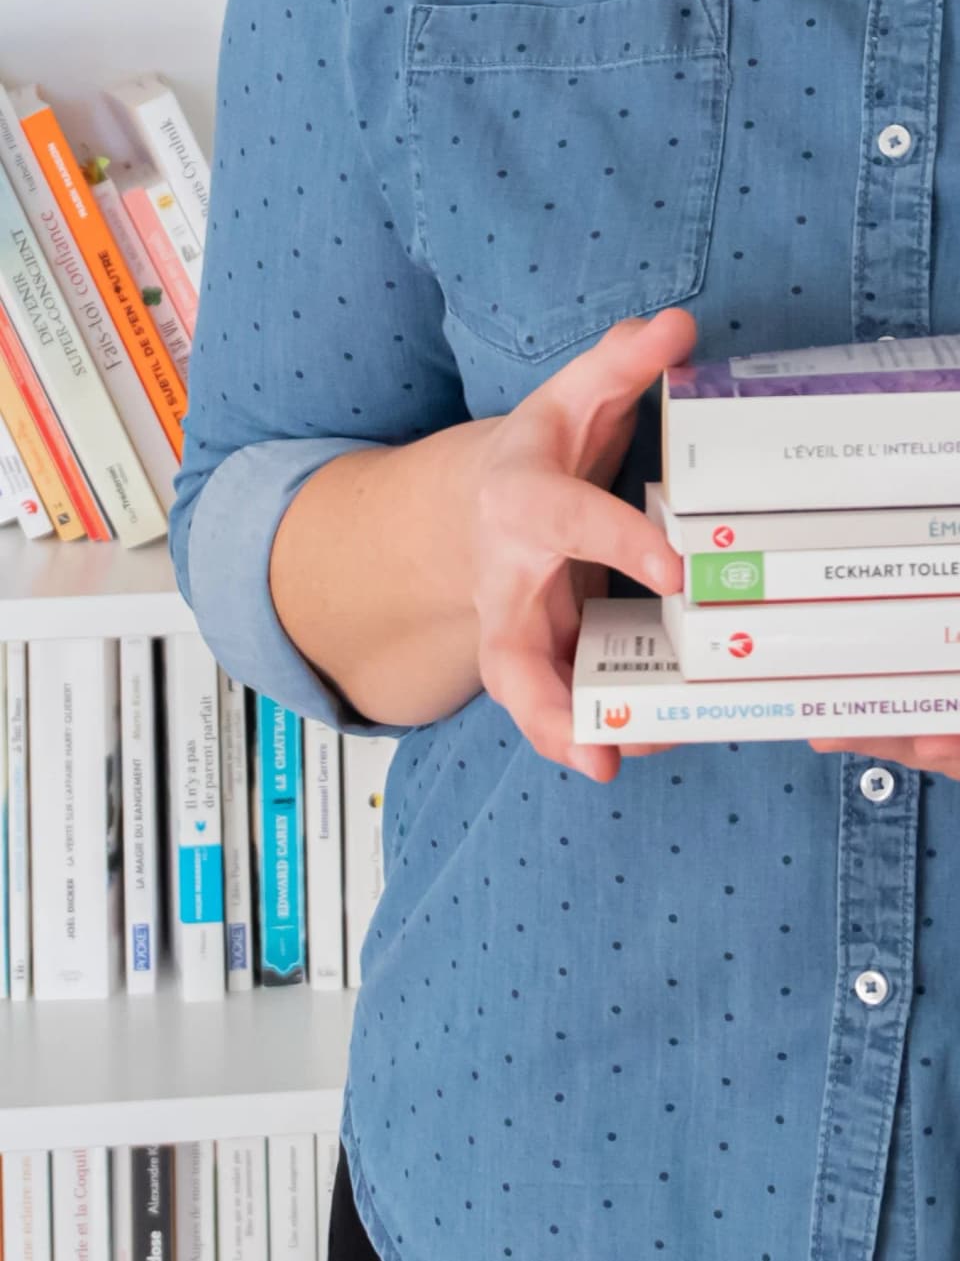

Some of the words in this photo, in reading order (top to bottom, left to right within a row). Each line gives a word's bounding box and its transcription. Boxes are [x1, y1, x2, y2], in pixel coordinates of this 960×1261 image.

[159, 117, 197, 180] Cyrulnik
[41, 210, 89, 296] confiance
[9, 228, 88, 377] SUPER-CONSCIENT
[12, 272, 54, 347] DEVENIR
[79, 300, 124, 372] Fais-toi
[123, 304, 146, 336] S'EN
[139, 335, 155, 358] DE
[150, 358, 178, 407] SUBTIL
[783, 444, 839, 460] L'ÉVEIL
[842, 443, 865, 458] DE
[824, 563, 904, 580] ECKHART
[909, 561, 960, 577] TOLLE
[201, 696, 217, 741] parfait
[655, 705, 691, 722] LES
[695, 702, 796, 720] POUVOIRS
[801, 701, 826, 717] DE
[186, 739, 201, 763] pas
[203, 743, 218, 789] parent
[132, 760, 144, 822] RANGEMENT
[184, 777, 201, 797] n'y
[275, 773, 287, 790] LE
[184, 800, 198, 810] Il
[202, 793, 215, 809] de
[133, 825, 145, 840] DU
[134, 877, 146, 890] LA
[276, 858, 290, 917] EDWARD
[73, 1148, 91, 1199] Coquil
